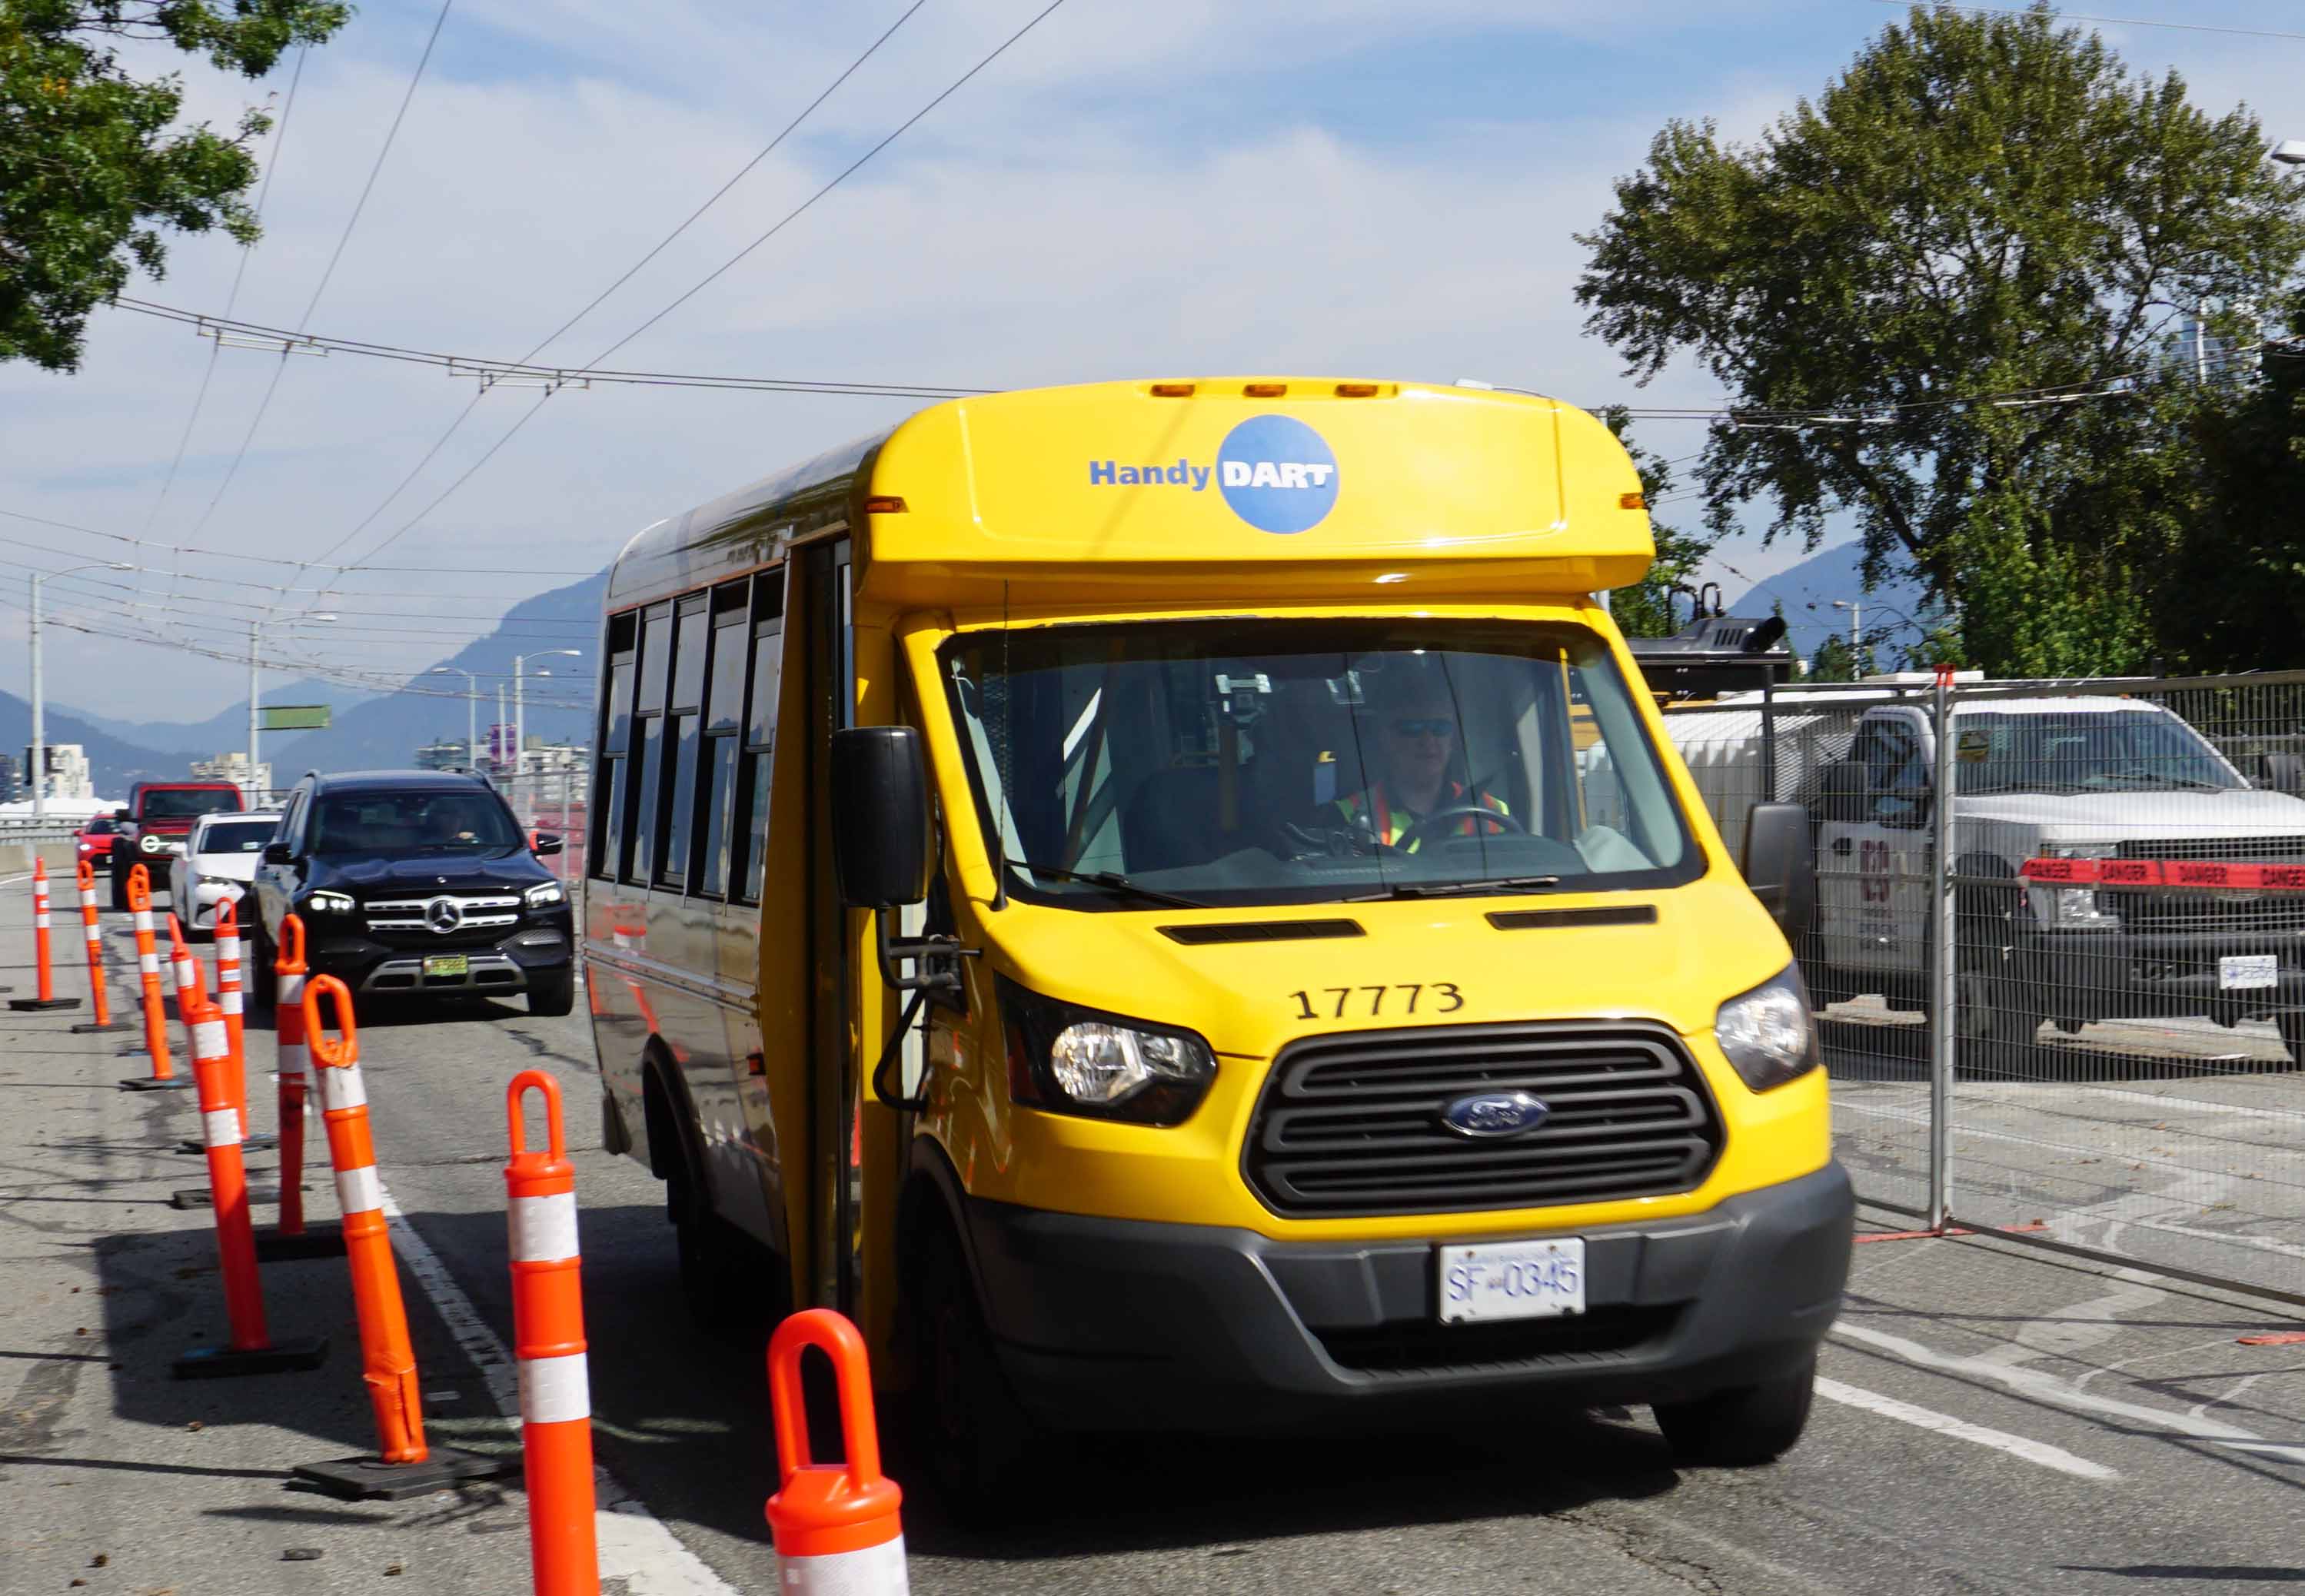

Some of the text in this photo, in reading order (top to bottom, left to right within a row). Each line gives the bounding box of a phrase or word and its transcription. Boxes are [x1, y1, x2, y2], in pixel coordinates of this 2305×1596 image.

[1089, 459, 1334, 491] Handy DART
[2100, 863, 2147, 881] DANGER
[2178, 866, 2227, 884] DANGER
[2261, 869, 2305, 886] DANGE
[1288, 983, 1464, 1019] 17773
